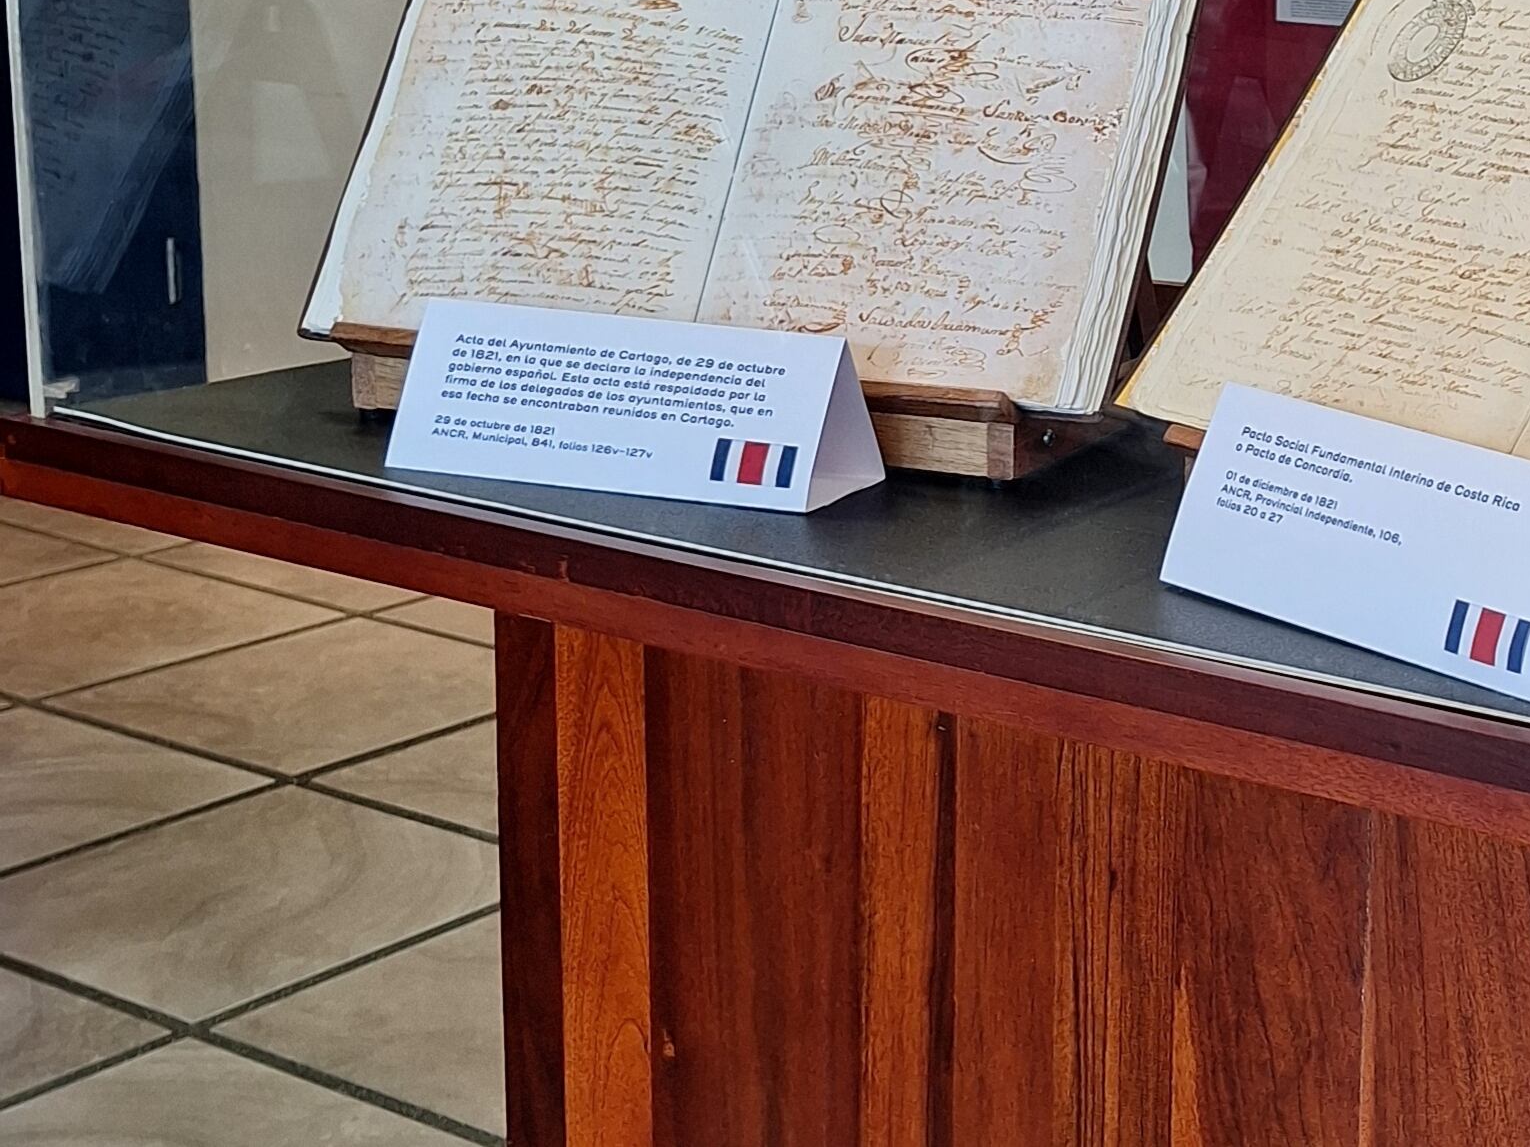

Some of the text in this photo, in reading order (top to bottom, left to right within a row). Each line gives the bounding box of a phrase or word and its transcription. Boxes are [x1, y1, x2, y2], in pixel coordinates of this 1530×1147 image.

[451, 348, 766, 388] de 1821, en la que se declara la independencia del
[455, 333, 786, 376] Acta del Ayuntamiento de Cartago, de 29 de octubre
[444, 374, 774, 417] firma de los delegados de los ayuntamientos, que en
[448, 362, 766, 402] gobierno español. Esta acta está respaldada por la
[434, 414, 556, 436] 29 de octubre de 1821
[440, 390, 735, 429] esa fecha se encontraban reunidos en Cartago.
[431, 427, 469, 440] ANCR,
[471, 431, 528, 447] Municipal,
[558, 440, 588, 452] folios
[1235, 443, 1244, 452] o
[1244, 443, 1277, 461] Pacto
[1277, 453, 1292, 466] de
[1241, 426, 1521, 512] Pacto Social Fundamental Interino de Costa Rica
[1216, 496, 1284, 524] folios 20 a 27
[1225, 470, 1338, 510] 01 de diciembre de 1821
[1220, 483, 1402, 547] ANCR, Provincial Independiente, 106,
